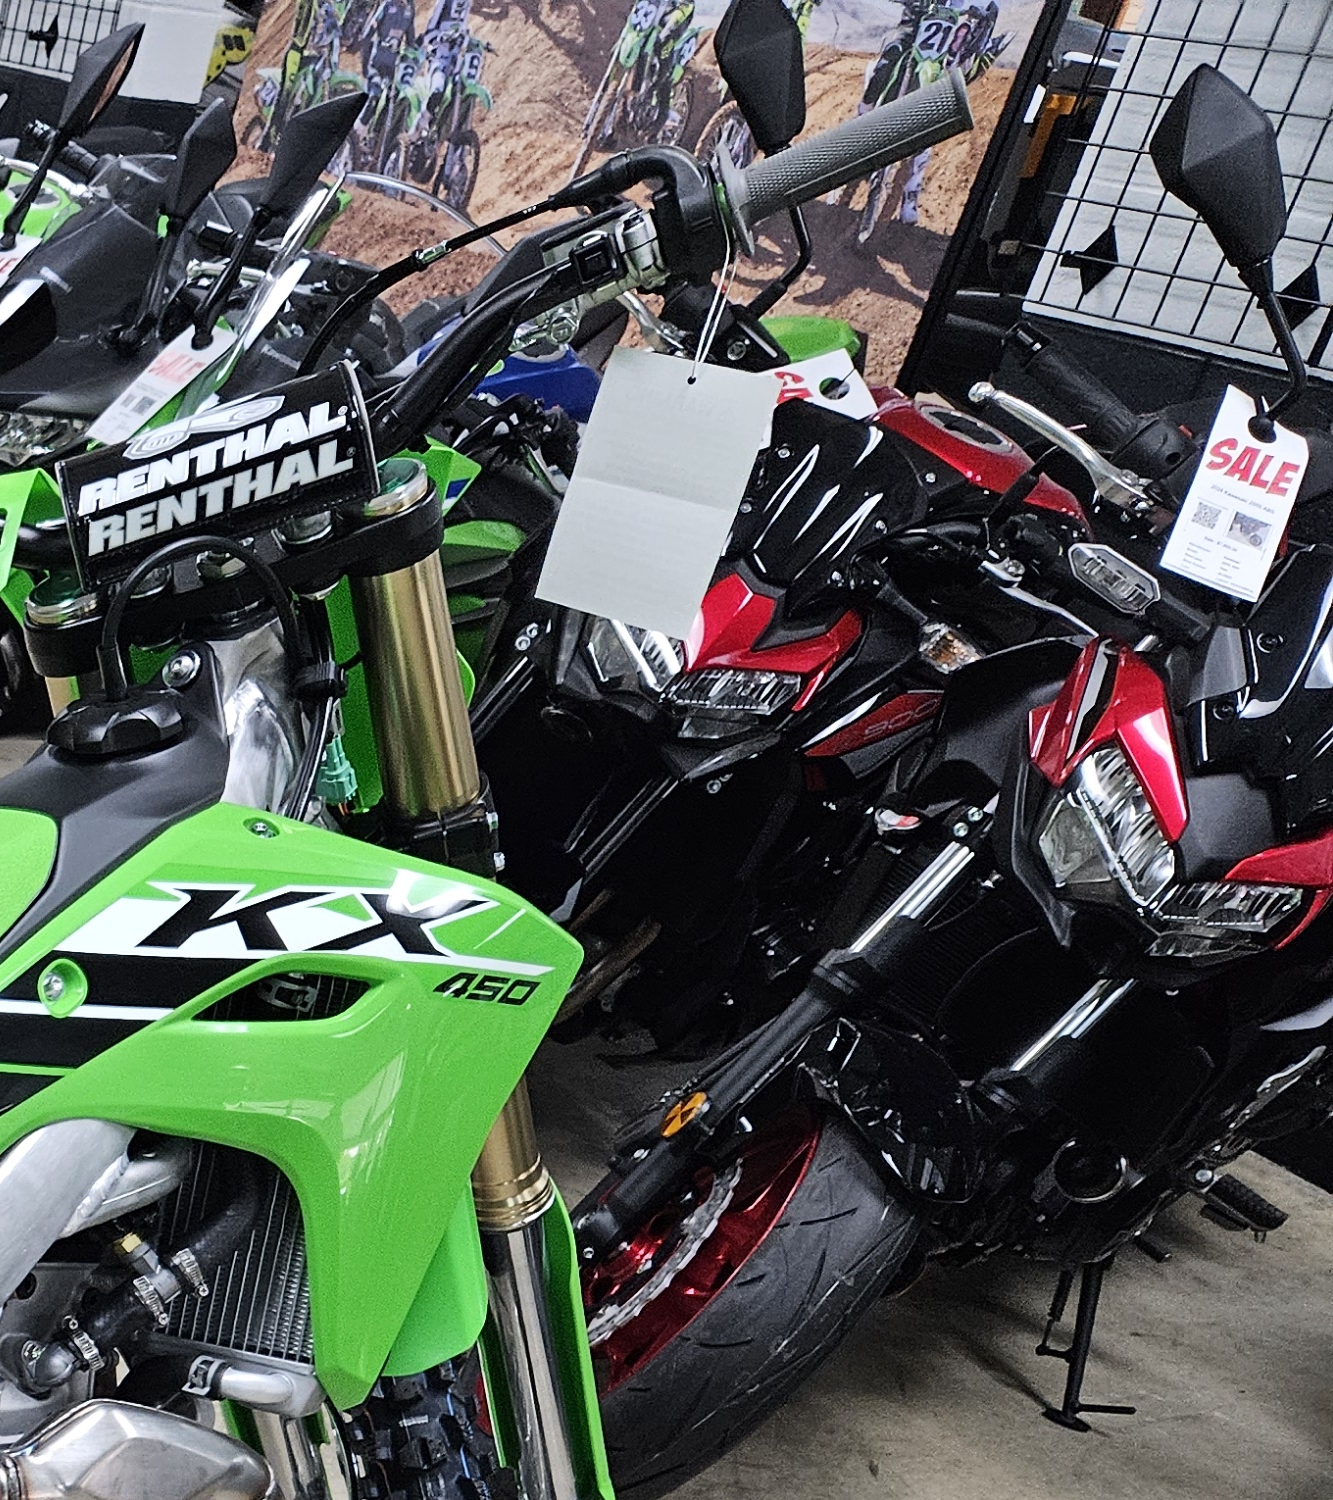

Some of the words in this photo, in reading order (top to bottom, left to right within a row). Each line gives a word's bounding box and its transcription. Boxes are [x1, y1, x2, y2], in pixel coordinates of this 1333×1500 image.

[78, 401, 347, 518] RENTHAL
[1204, 437, 1301, 498] SALE
[88, 439, 355, 557] RENTHAL
[133, 887, 493, 958] KX
[433, 972, 541, 1007] 450
